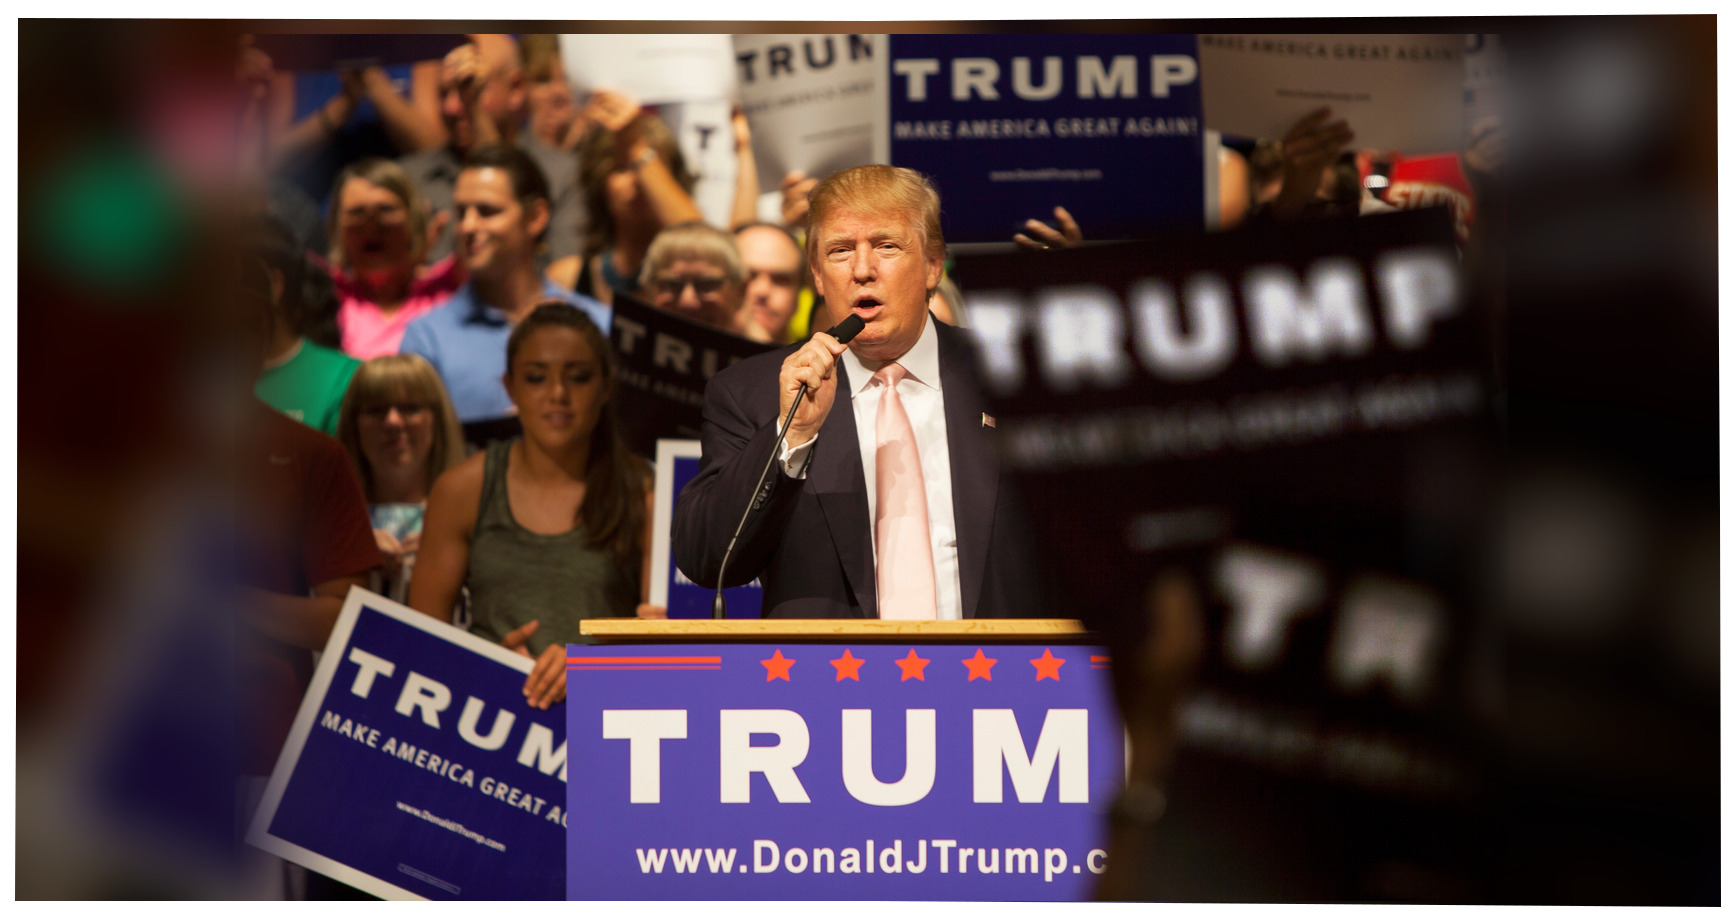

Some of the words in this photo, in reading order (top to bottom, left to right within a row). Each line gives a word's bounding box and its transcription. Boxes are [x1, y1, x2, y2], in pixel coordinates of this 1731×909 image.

[893, 54, 1199, 101] TRUMP
[894, 121, 951, 140] MAKE
[957, 118, 1050, 139] AMERICA
[1054, 117, 1120, 138] GREAT
[1124, 116, 1198, 137] AGAIN!
[966, 248, 1464, 395] TRUMP
[320, 710, 381, 749] MAKE
[381, 737, 474, 789] AMERICA
[479, 776, 547, 816] GREAT
[348, 646, 567, 784] TRUM
[602, 708, 1134, 806] TRUM
